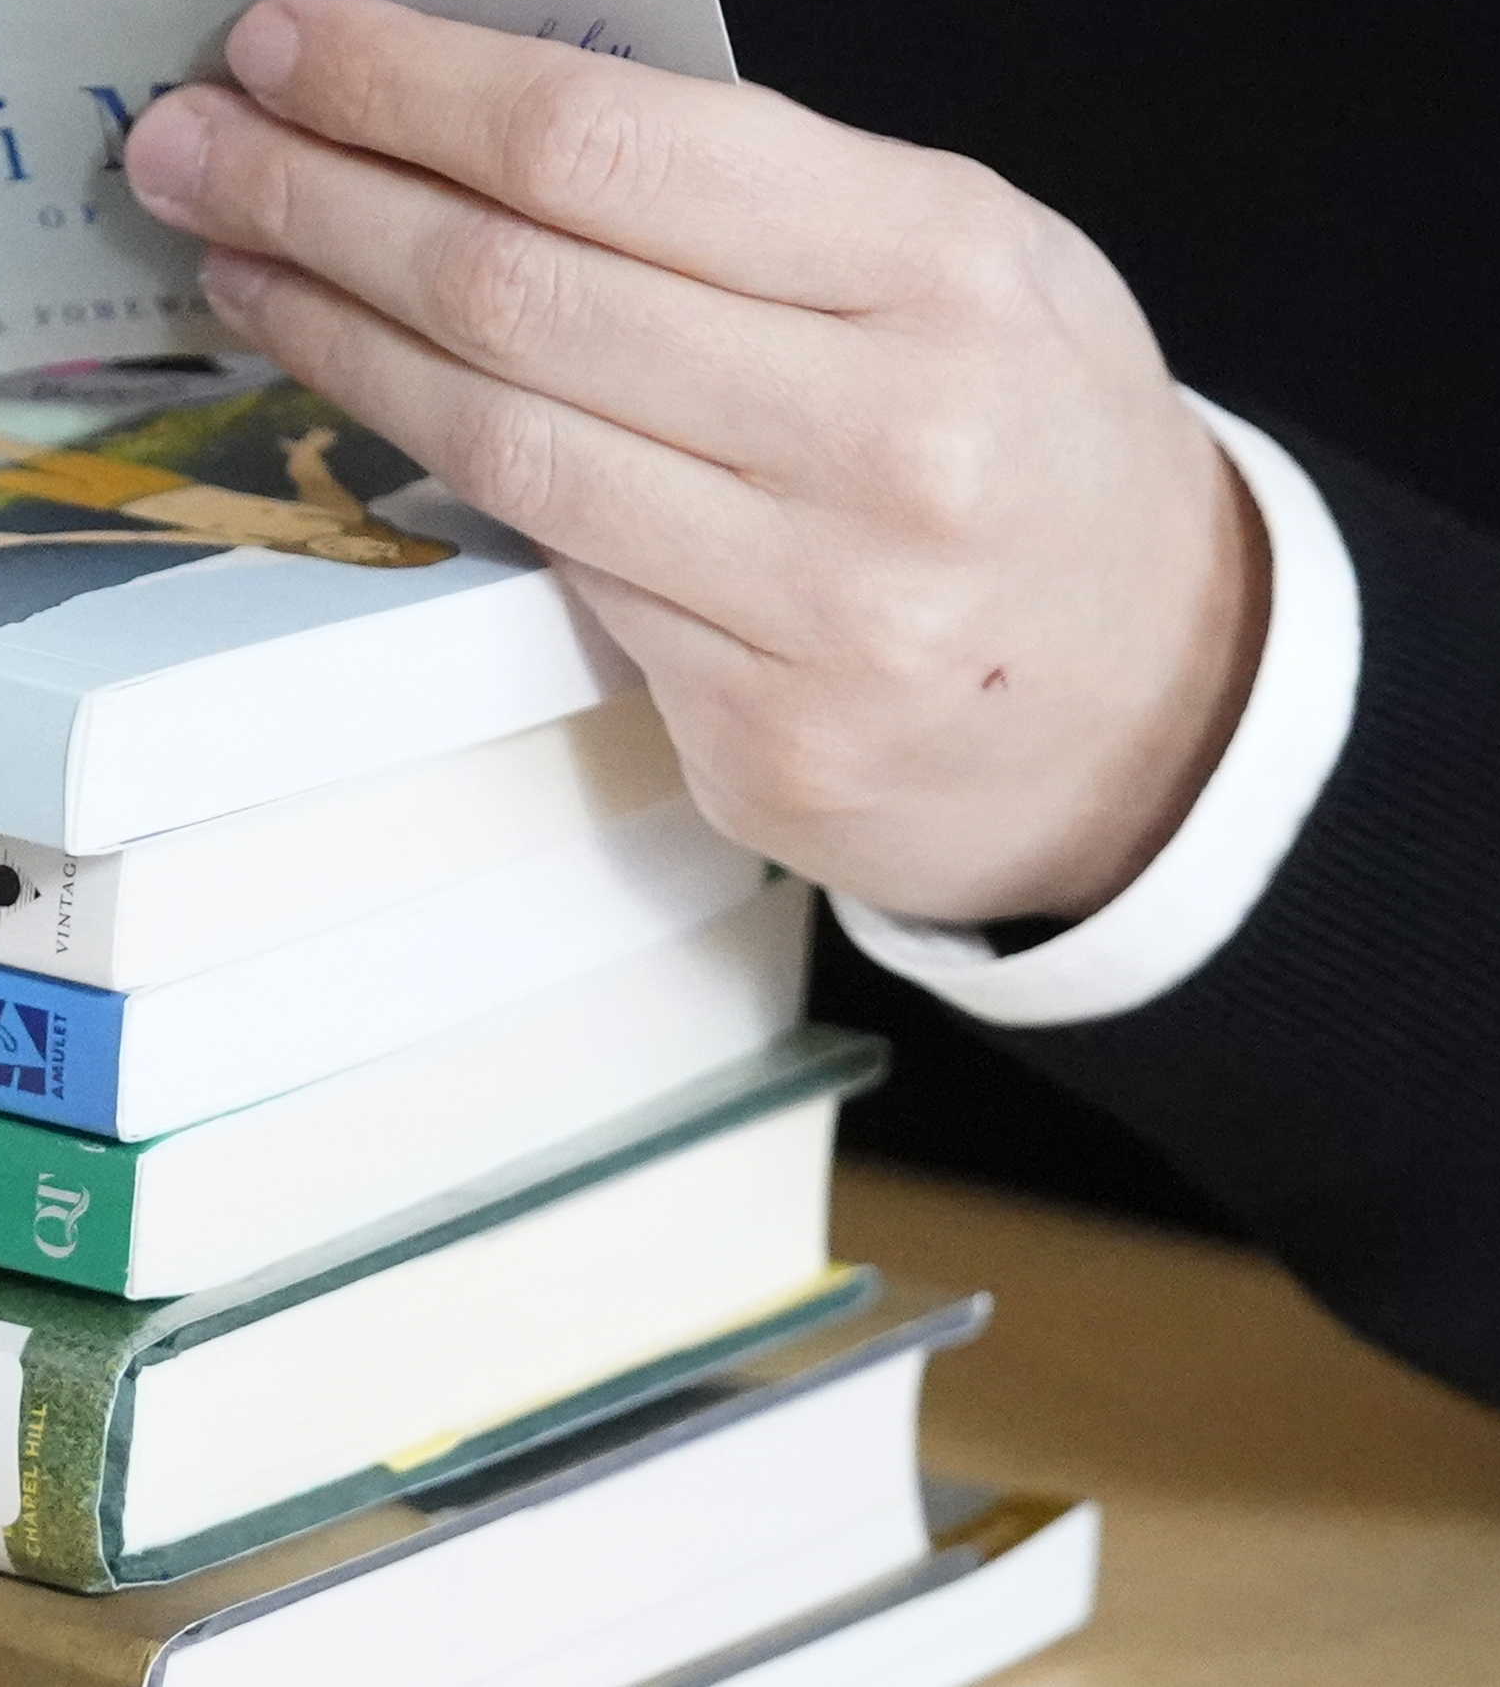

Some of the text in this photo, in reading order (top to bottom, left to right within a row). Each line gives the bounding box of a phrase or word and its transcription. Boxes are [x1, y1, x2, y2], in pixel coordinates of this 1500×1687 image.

[56, 853, 80, 955] VINTAG
[50, 1013, 69, 1101] AMULET
[24, 1403, 48, 1458] HILL
